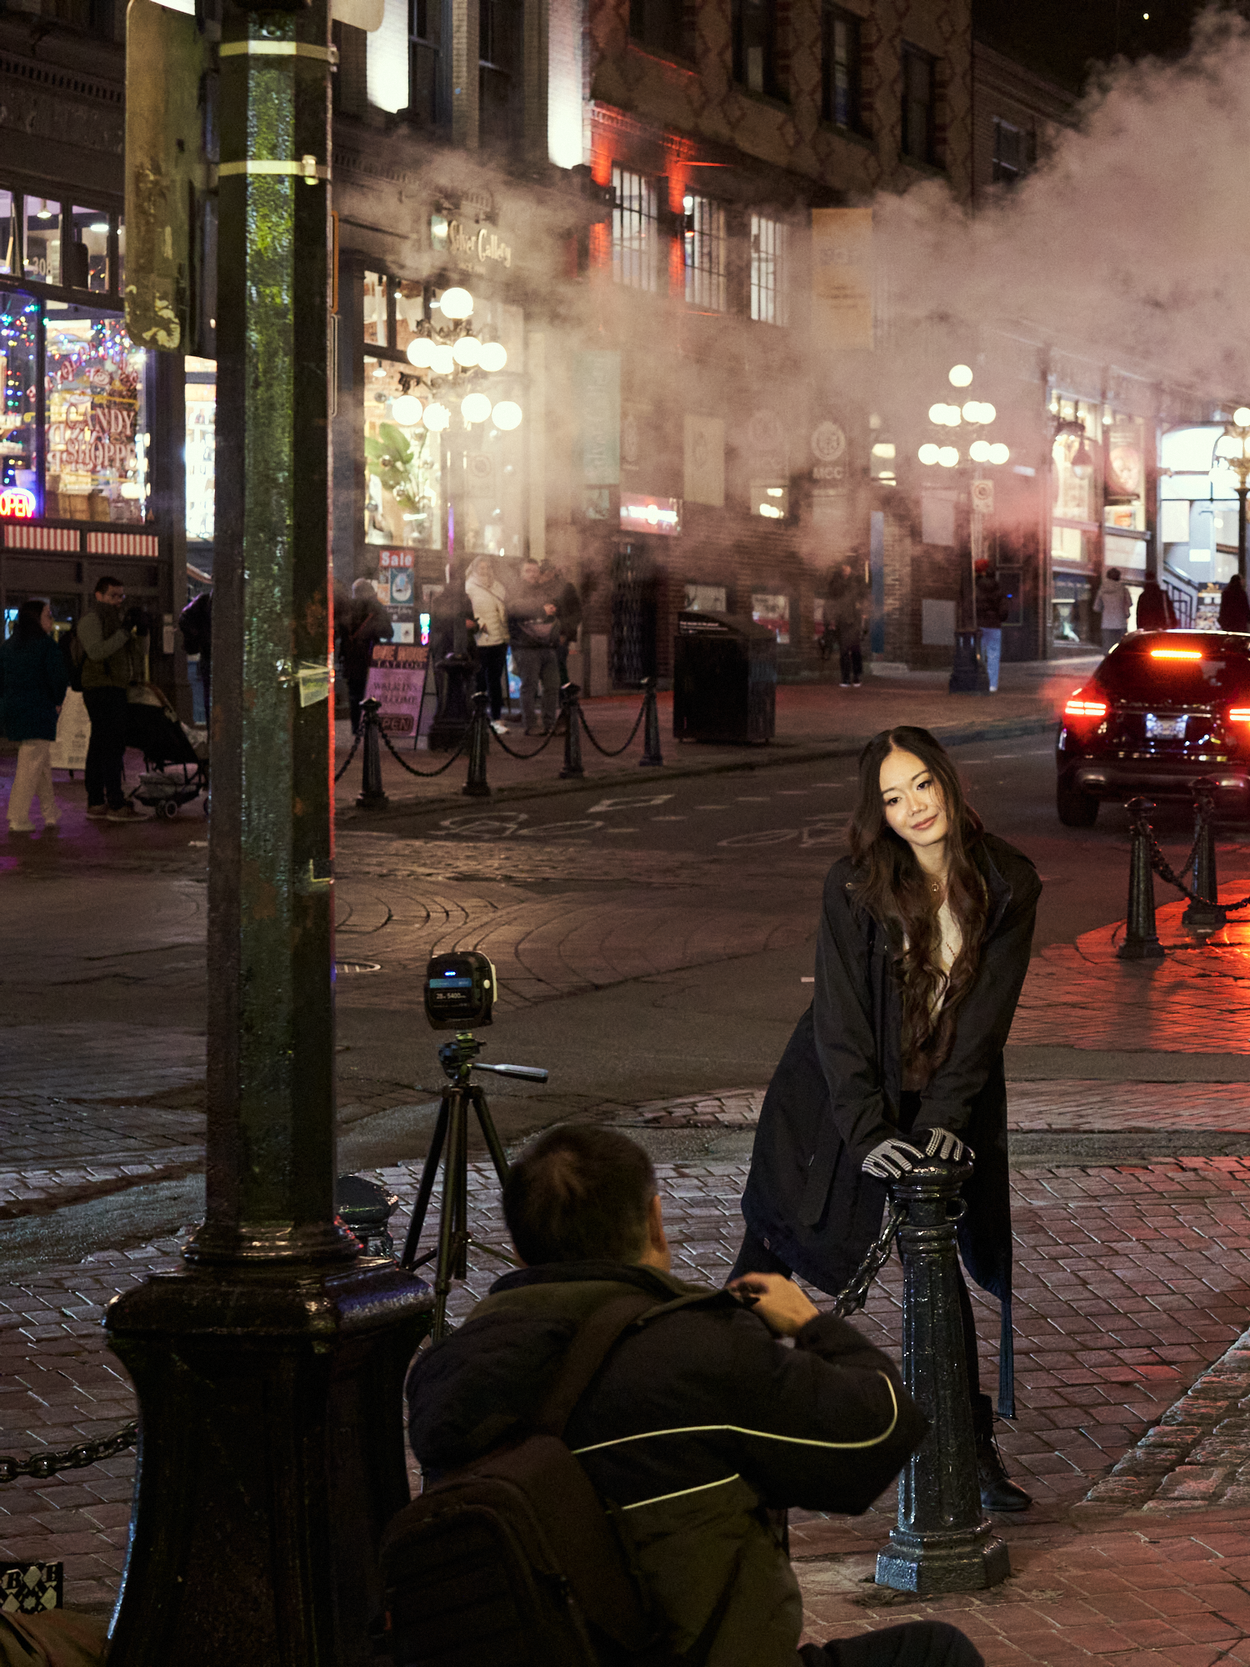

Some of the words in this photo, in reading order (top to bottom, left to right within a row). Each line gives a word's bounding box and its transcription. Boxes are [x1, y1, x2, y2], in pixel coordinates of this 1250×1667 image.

[478, 228, 511, 268] Gallery
[67, 403, 135, 435] CANDY
[67, 439, 137, 472] SHOPPE
[0, 494, 32, 518] OPEN
[381, 551, 412, 567] Sale
[381, 717, 410, 731] PEN
